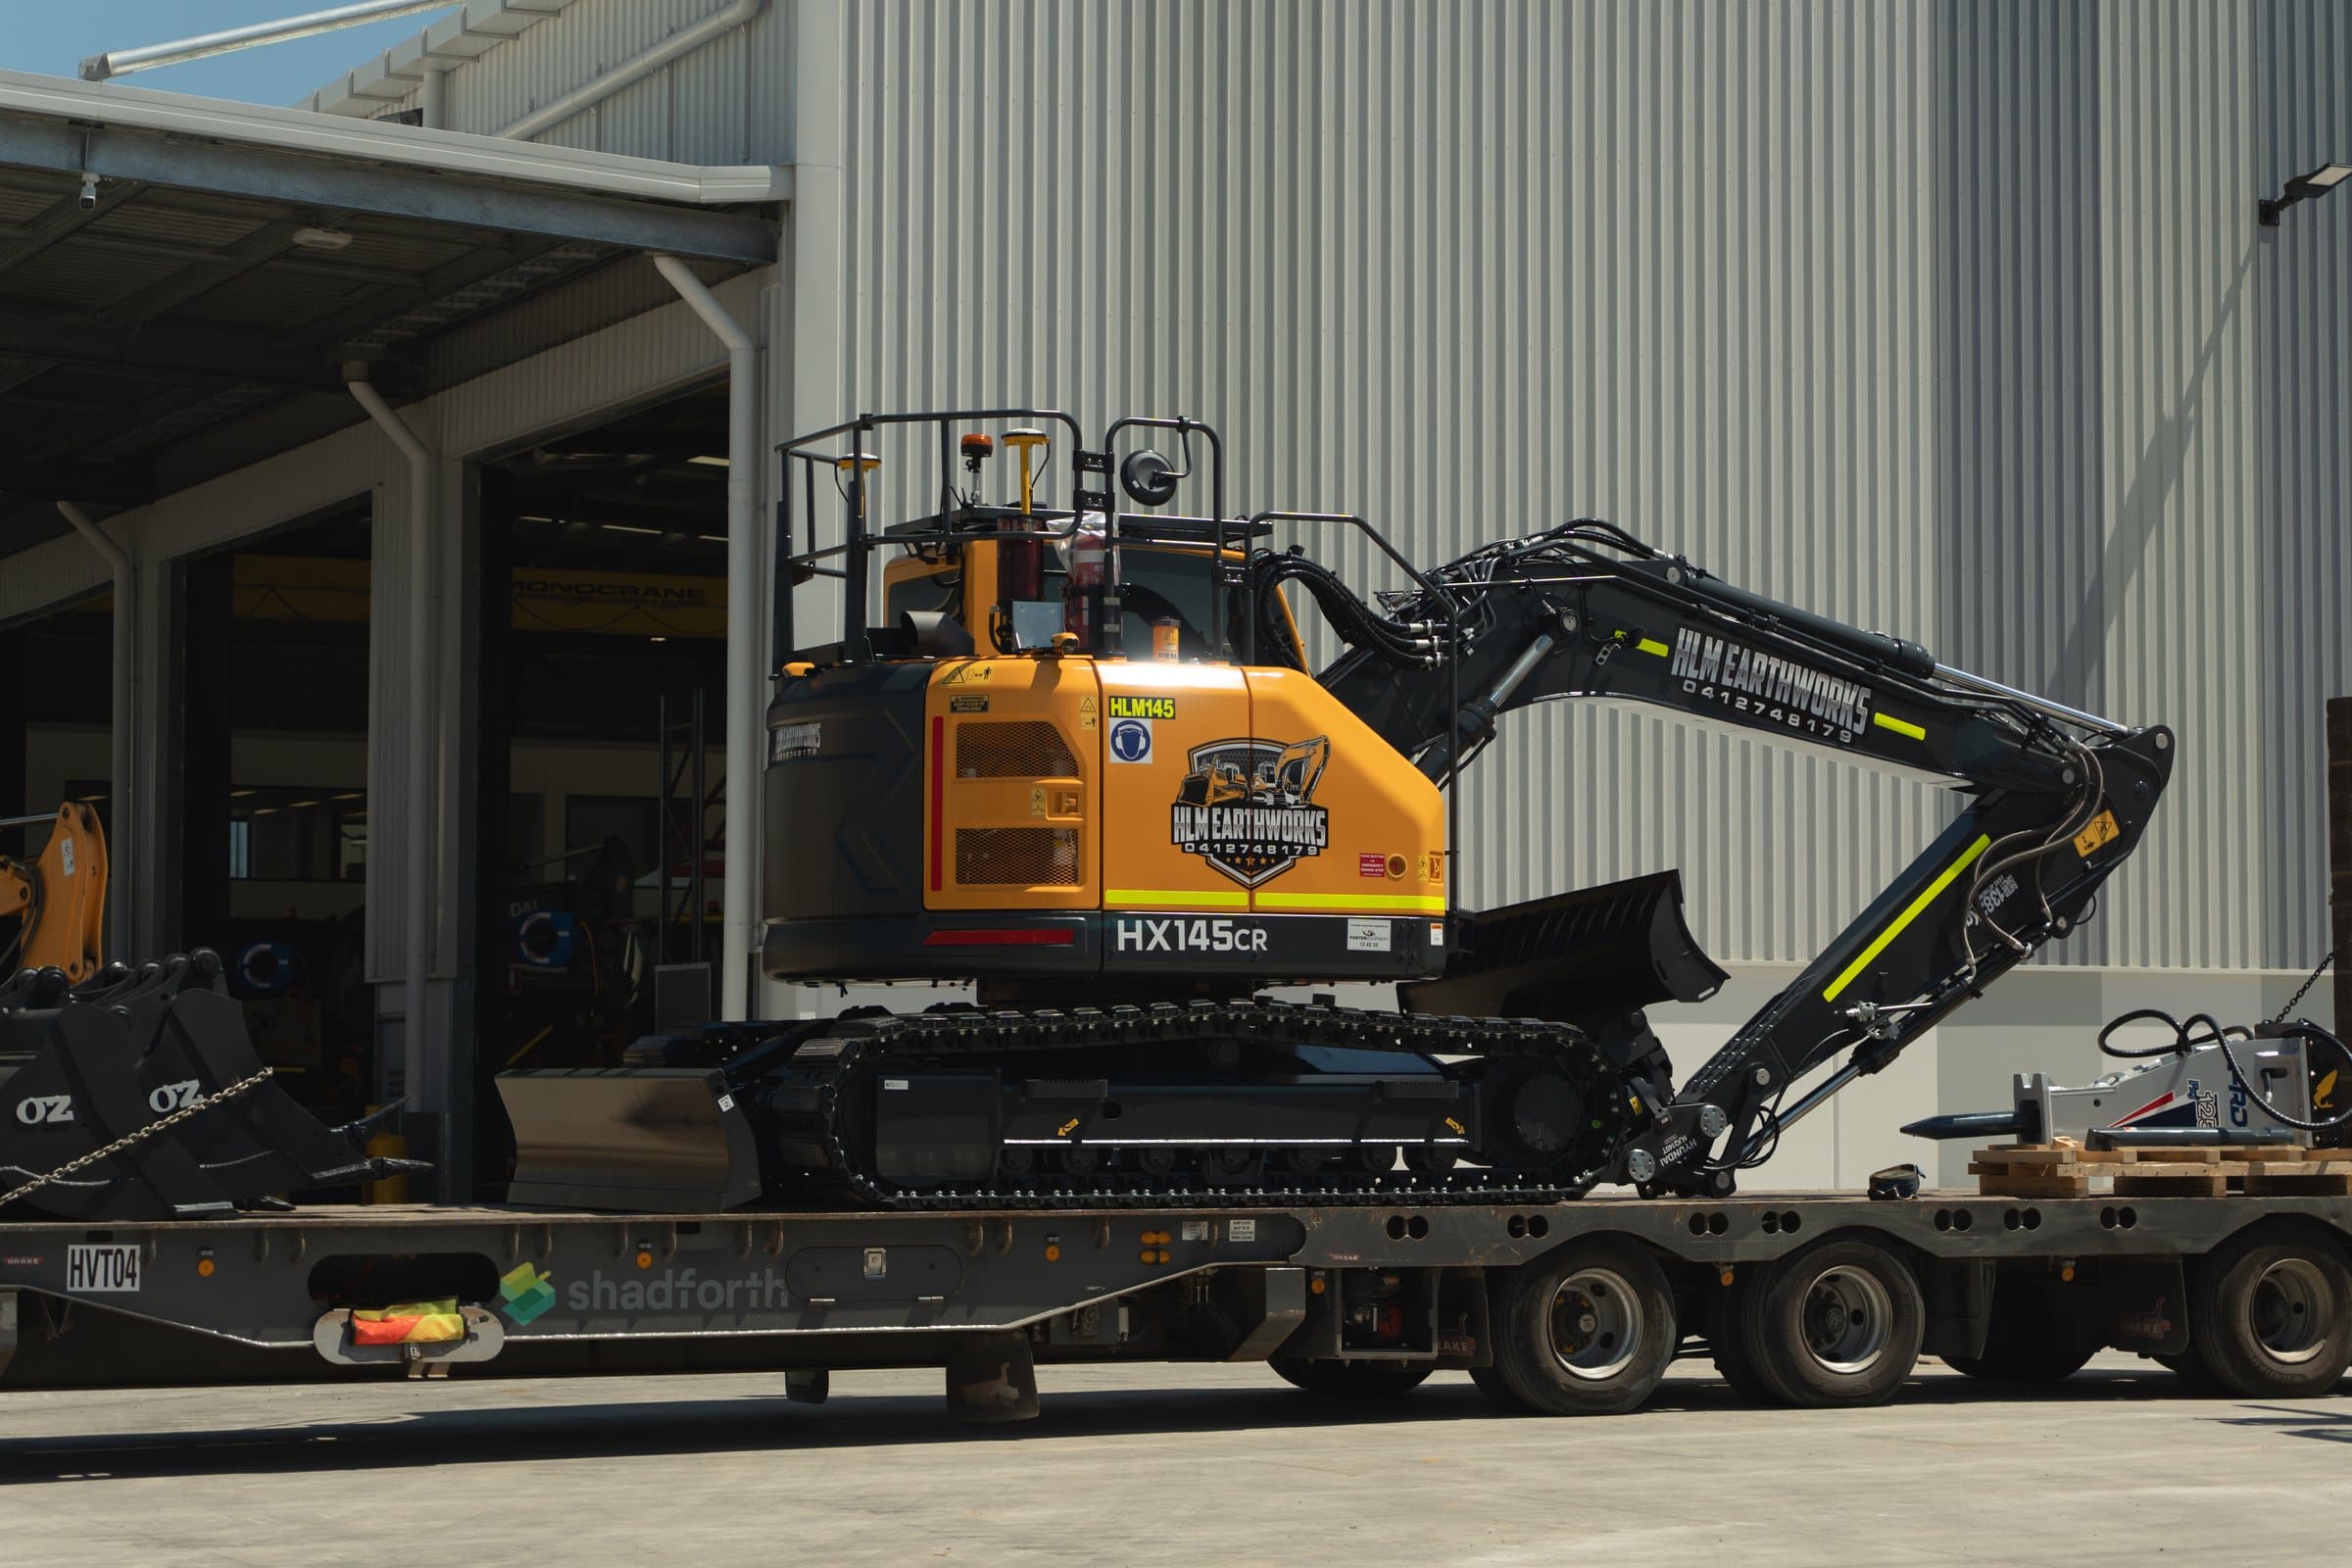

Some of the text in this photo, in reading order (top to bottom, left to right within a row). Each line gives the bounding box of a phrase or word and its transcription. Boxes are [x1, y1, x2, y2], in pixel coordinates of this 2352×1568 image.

[512, 580, 707, 599] MONOCRANE
[1671, 627, 1872, 735] HLM EARTHWORKS
[1110, 697, 1175, 718] HLM145
[1683, 678, 1852, 745] 0412748179
[1173, 807, 1326, 848] HLM EARTHWORKS
[1184, 843, 1318, 856] 0412748179
[1117, 919, 1268, 952] HX145CR
[16, 1095, 74, 1124] OZ
[1659, 1138, 1697, 1166] HYUNDAI
[70, 1249, 136, 1288] HVT04
[568, 1267, 790, 1310] shadforth
